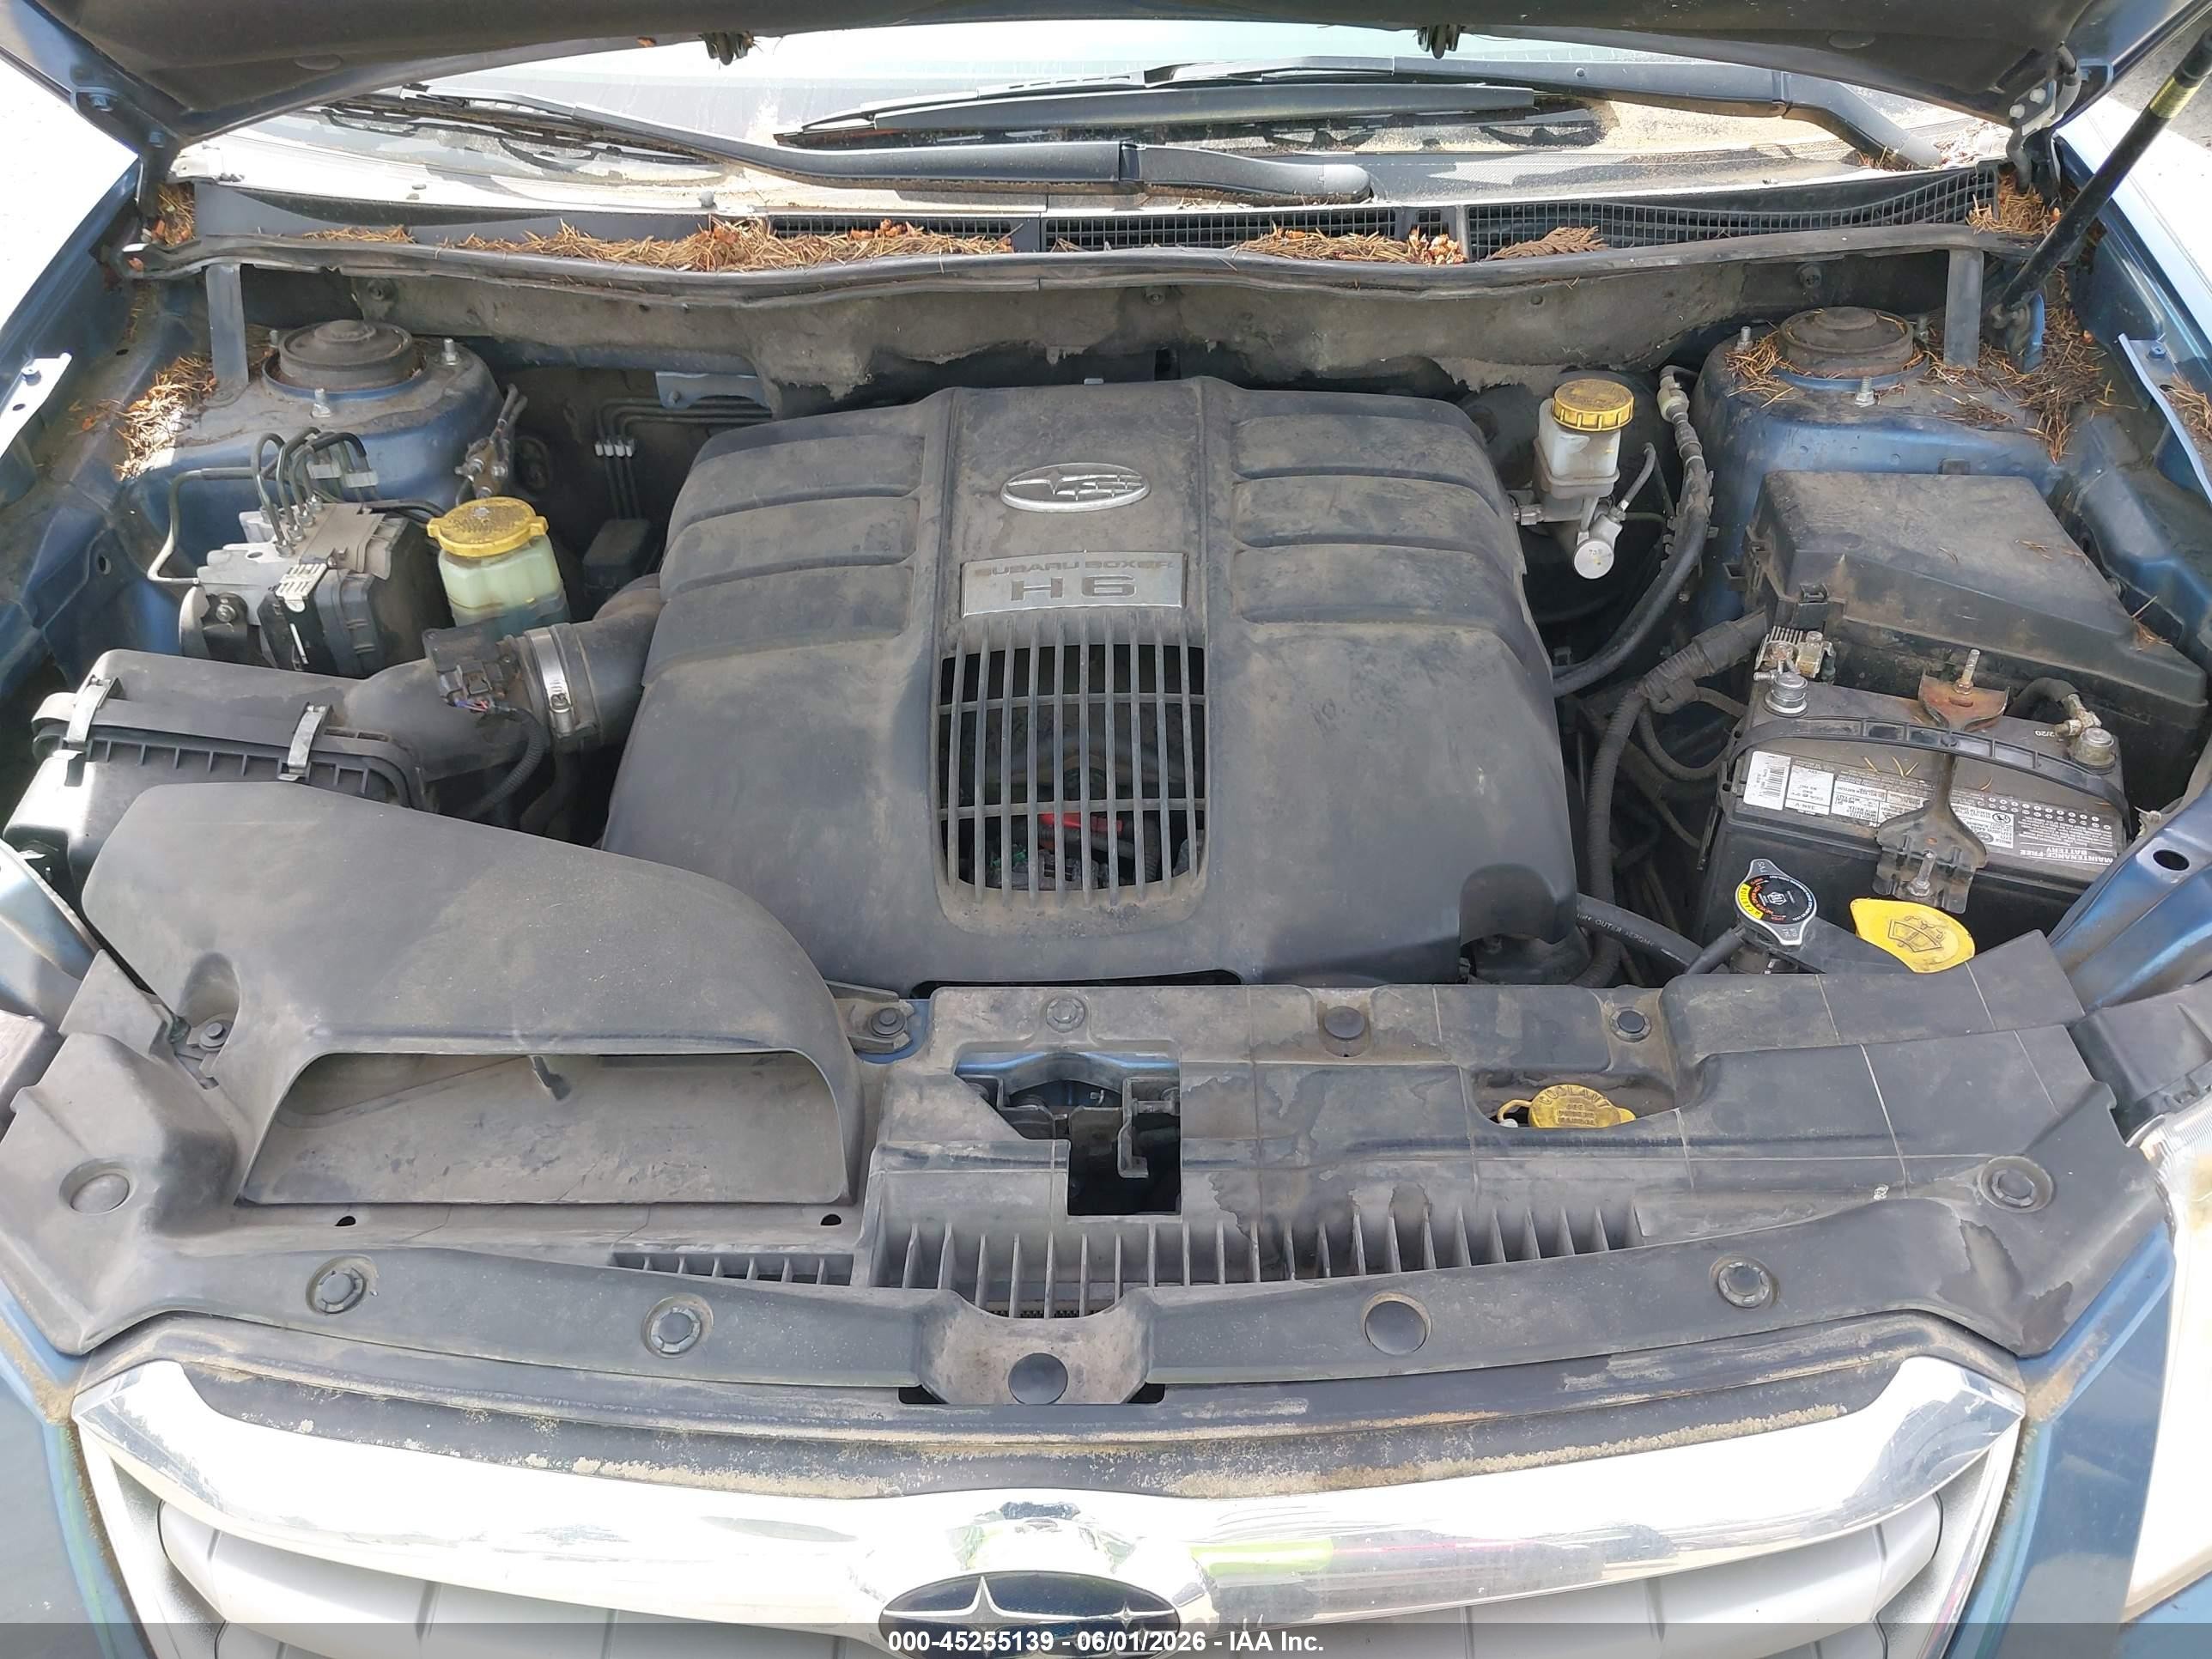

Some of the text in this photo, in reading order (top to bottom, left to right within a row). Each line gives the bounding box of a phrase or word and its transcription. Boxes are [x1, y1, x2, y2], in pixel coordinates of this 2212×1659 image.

[974, 560, 1172, 576] SUBARU BOXER
[2020, 850, 2113, 863] MAINTENANCE-FREE
[2046, 847, 2087, 855] BATTERY
[1741, 887, 1753, 912] CAUTION
[1538, 1085, 1610, 1108] COOLANT
